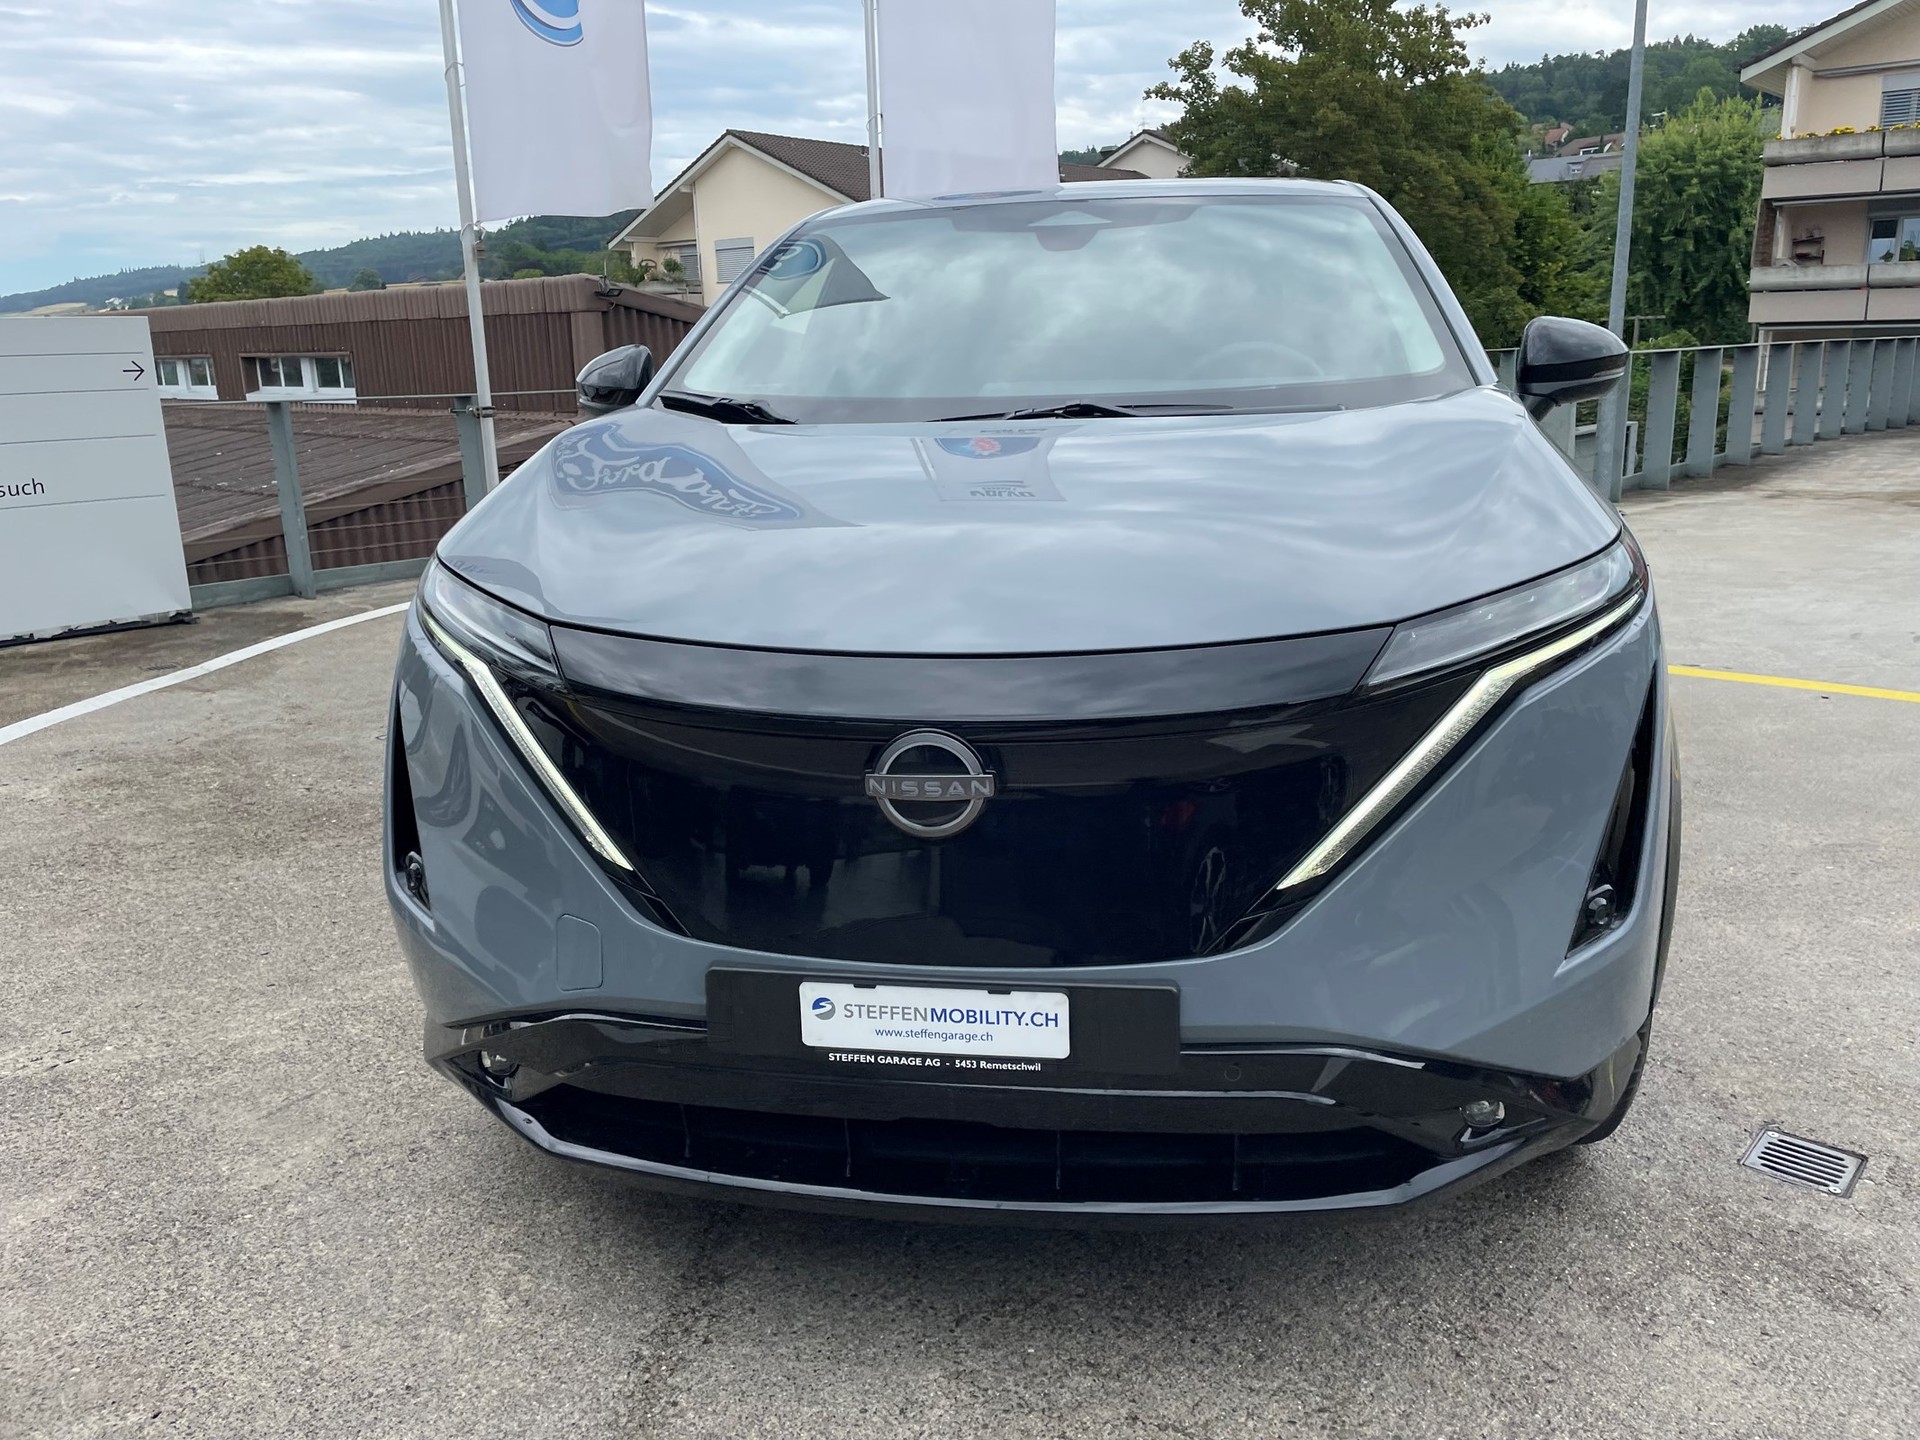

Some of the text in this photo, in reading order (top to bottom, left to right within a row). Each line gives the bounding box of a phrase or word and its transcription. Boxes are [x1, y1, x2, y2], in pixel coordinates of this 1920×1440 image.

[868, 777, 991, 798] NISSAN
[843, 1003, 1059, 1028] STEFFENMOBILITY.CH
[874, 1028, 994, 1043] www.steffengarage.ch
[828, 1052, 875, 1064] STEFFEN
[877, 1055, 923, 1066] GARAGE
[924, 1057, 941, 1067] AG
[955, 1059, 977, 1069] 5453
[979, 1061, 1041, 1072] Remetschwil
